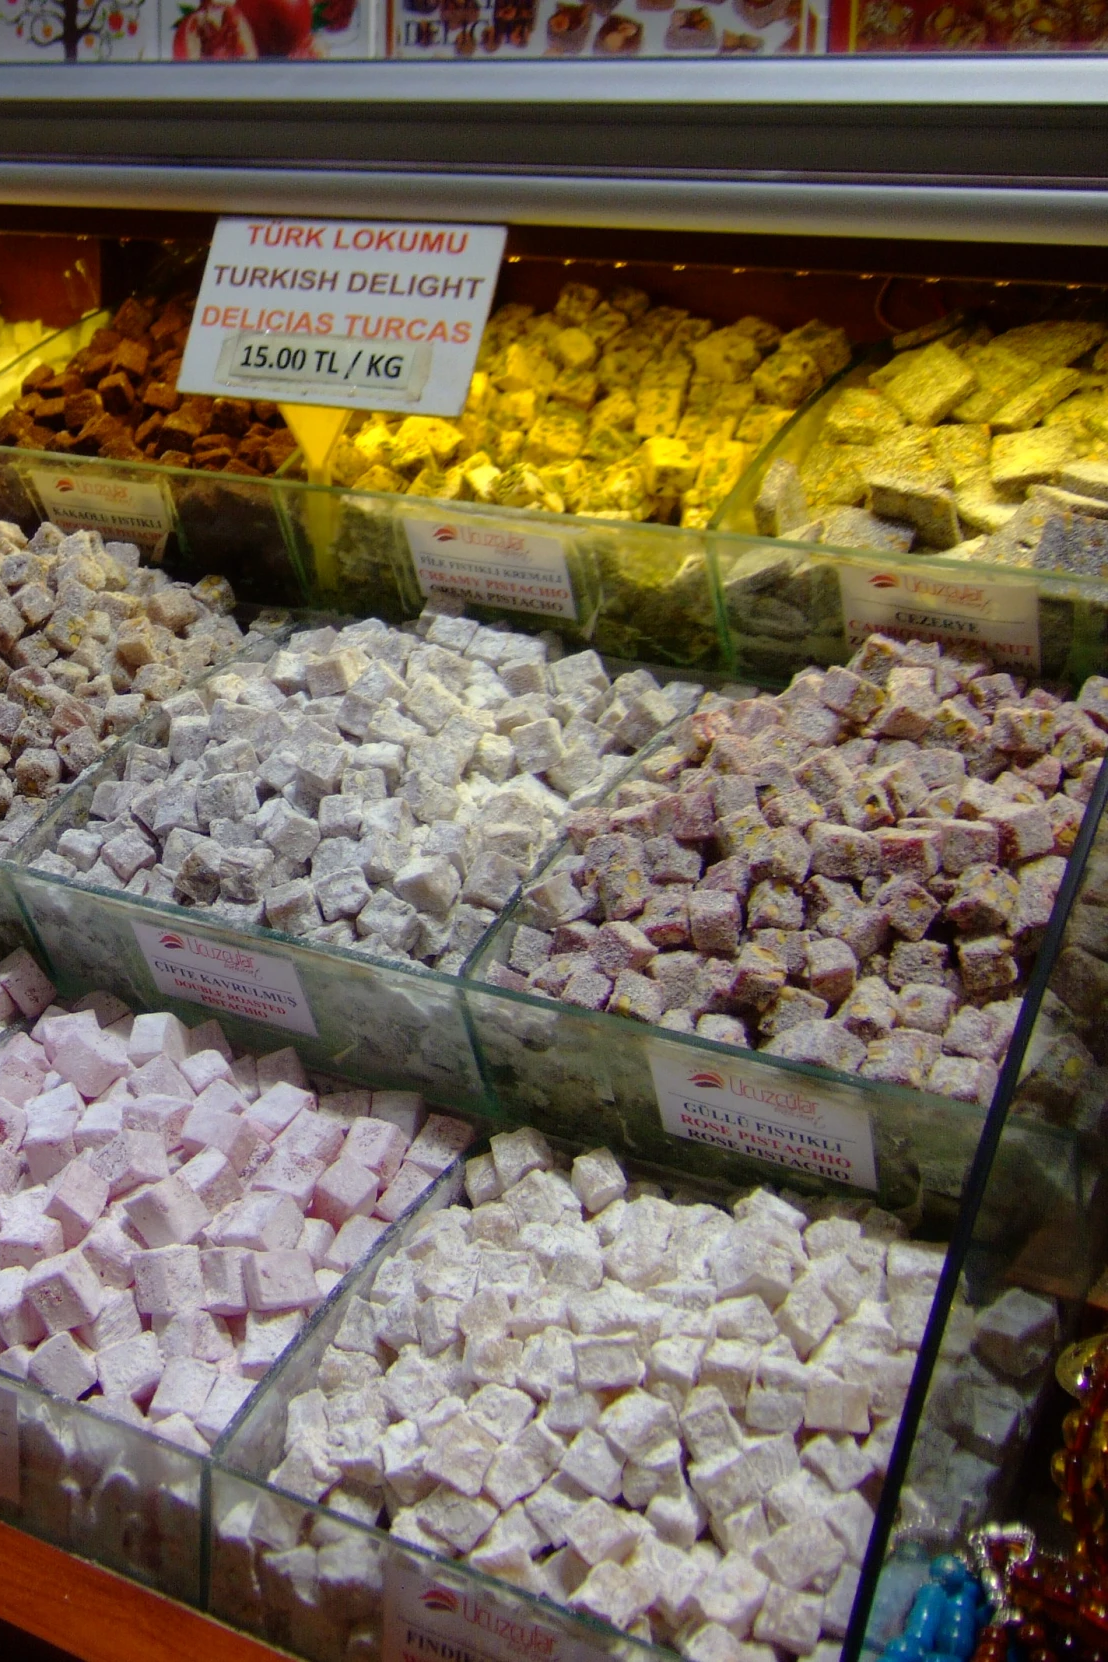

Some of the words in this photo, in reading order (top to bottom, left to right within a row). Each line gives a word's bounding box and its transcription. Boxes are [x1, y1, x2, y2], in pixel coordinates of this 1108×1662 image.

[248, 221, 326, 248] TÜRK
[333, 227, 469, 254] LOKUMU
[214, 265, 340, 292] TURKISH
[346, 271, 485, 300] DELIGHT
[200, 305, 334, 334] DELICIAS
[344, 315, 472, 344] TURCAS
[240, 344, 306, 371] 15.00
[315, 350, 339, 373] TL
[344, 350, 362, 379] /
[366, 354, 404, 379] KG
[174, 978, 225, 999] DOUBLE
[680, 1113, 732, 1137] ROSE
[738, 1129, 852, 1169] PISTACHIO
[683, 1101, 750, 1128] GÜLLÜ
[756, 1122, 842, 1152] FISTIKLI
[687, 1128, 740, 1151] ROSE
[746, 1145, 850, 1181] PISTACHO
